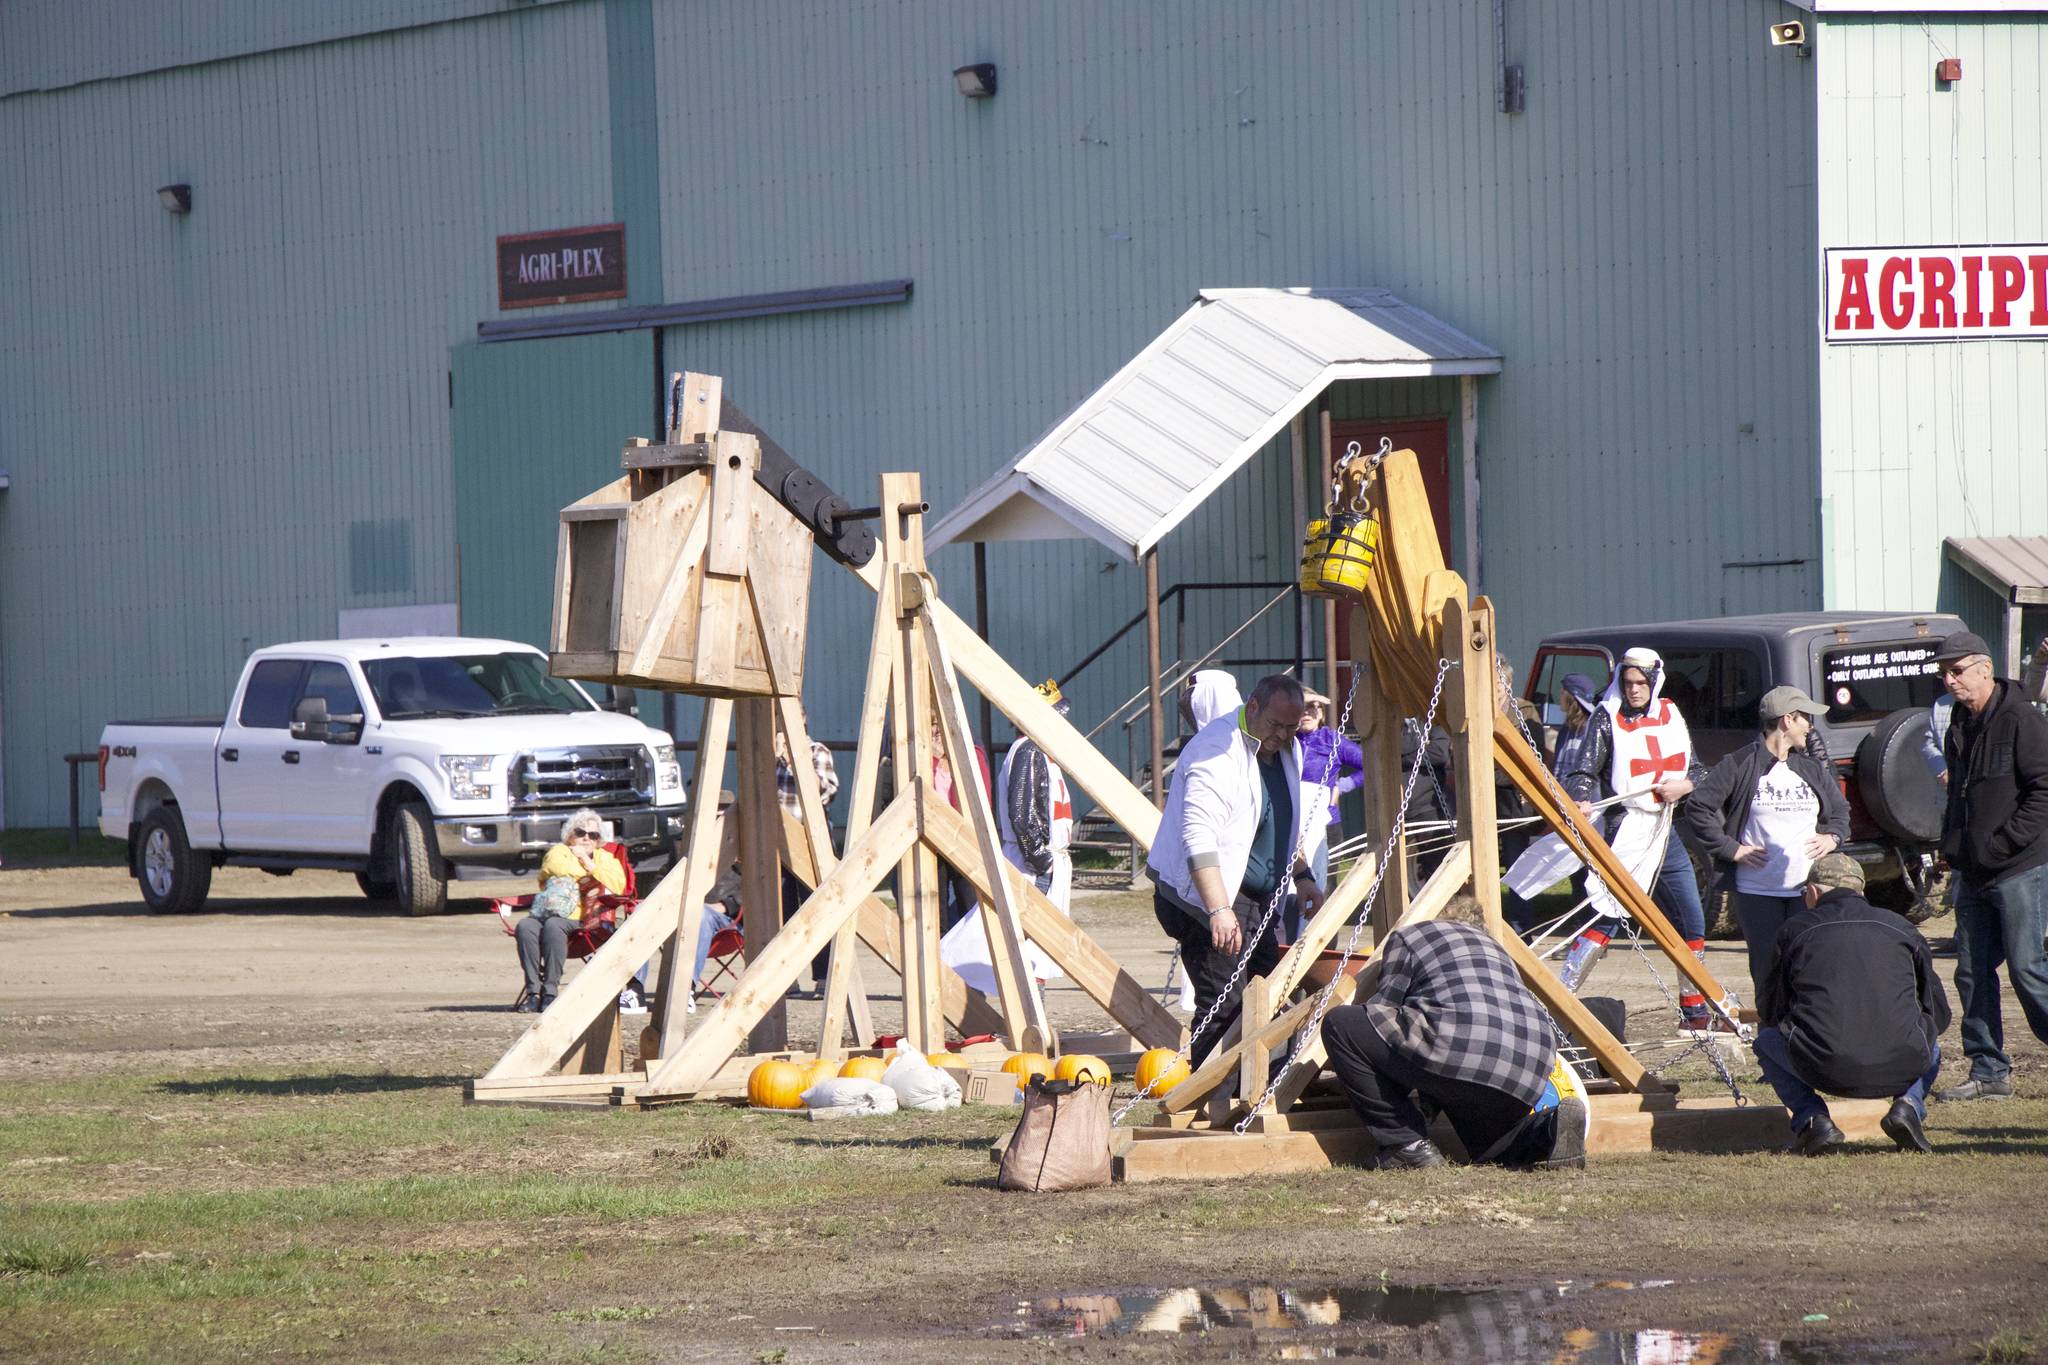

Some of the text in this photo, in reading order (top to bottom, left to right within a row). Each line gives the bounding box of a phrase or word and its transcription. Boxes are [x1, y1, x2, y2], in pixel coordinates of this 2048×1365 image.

[518, 247, 605, 284] AGRI-PLEX
[1851, 654, 1871, 666] GUNS
[1874, 652, 1888, 665] ARE
[1852, 667, 1885, 681] OUTLAWS
[1885, 666, 1902, 678] WILL
[1902, 664, 1921, 676] HAVE
